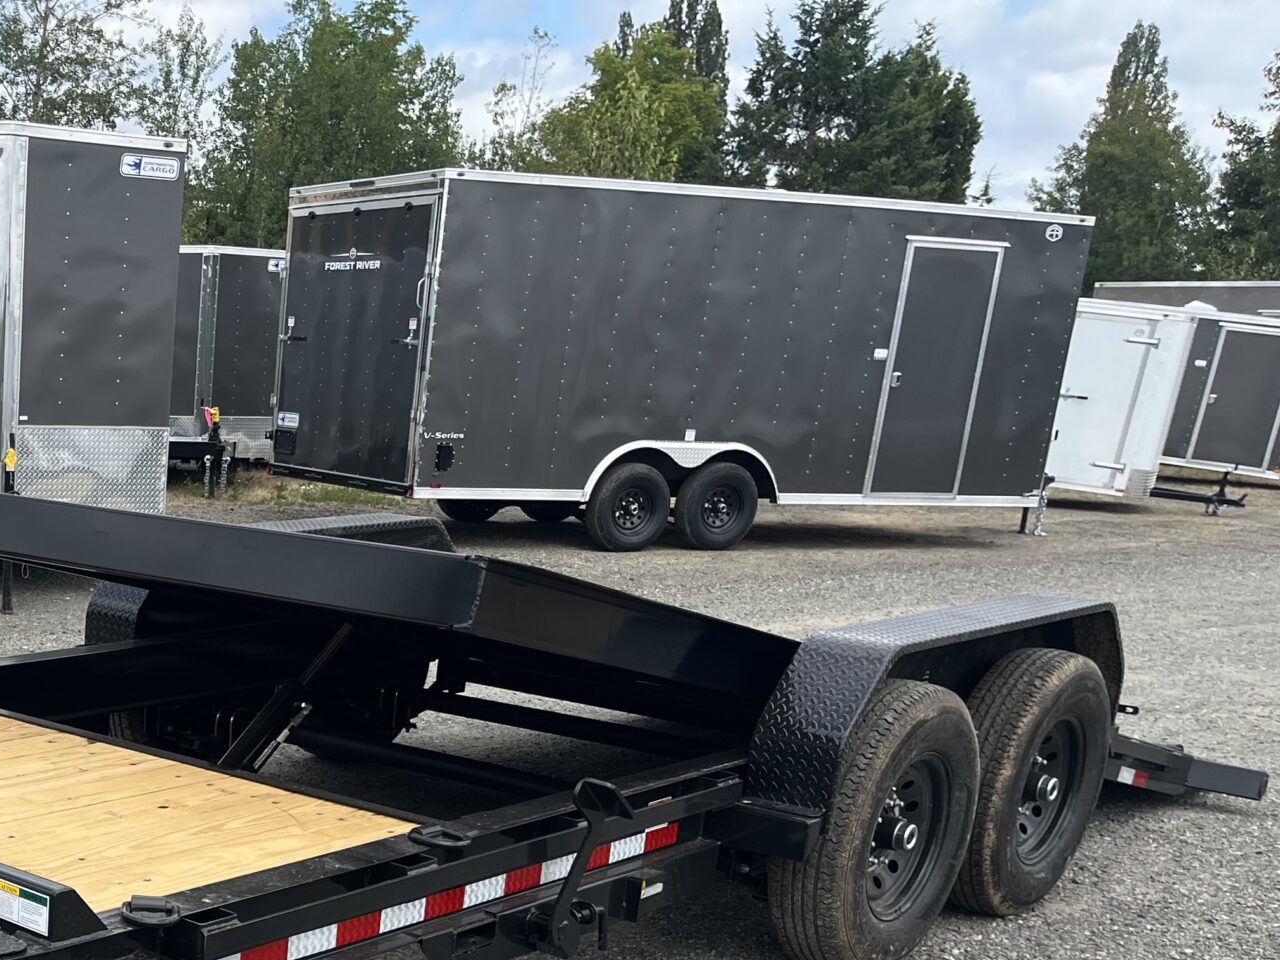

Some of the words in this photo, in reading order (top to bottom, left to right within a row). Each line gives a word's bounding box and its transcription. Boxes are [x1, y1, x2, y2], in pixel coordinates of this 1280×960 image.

[142, 165, 175, 174] CARGO
[324, 261, 355, 270] FOREST
[356, 260, 381, 270] RIVER
[423, 431, 465, 439] V-Series
